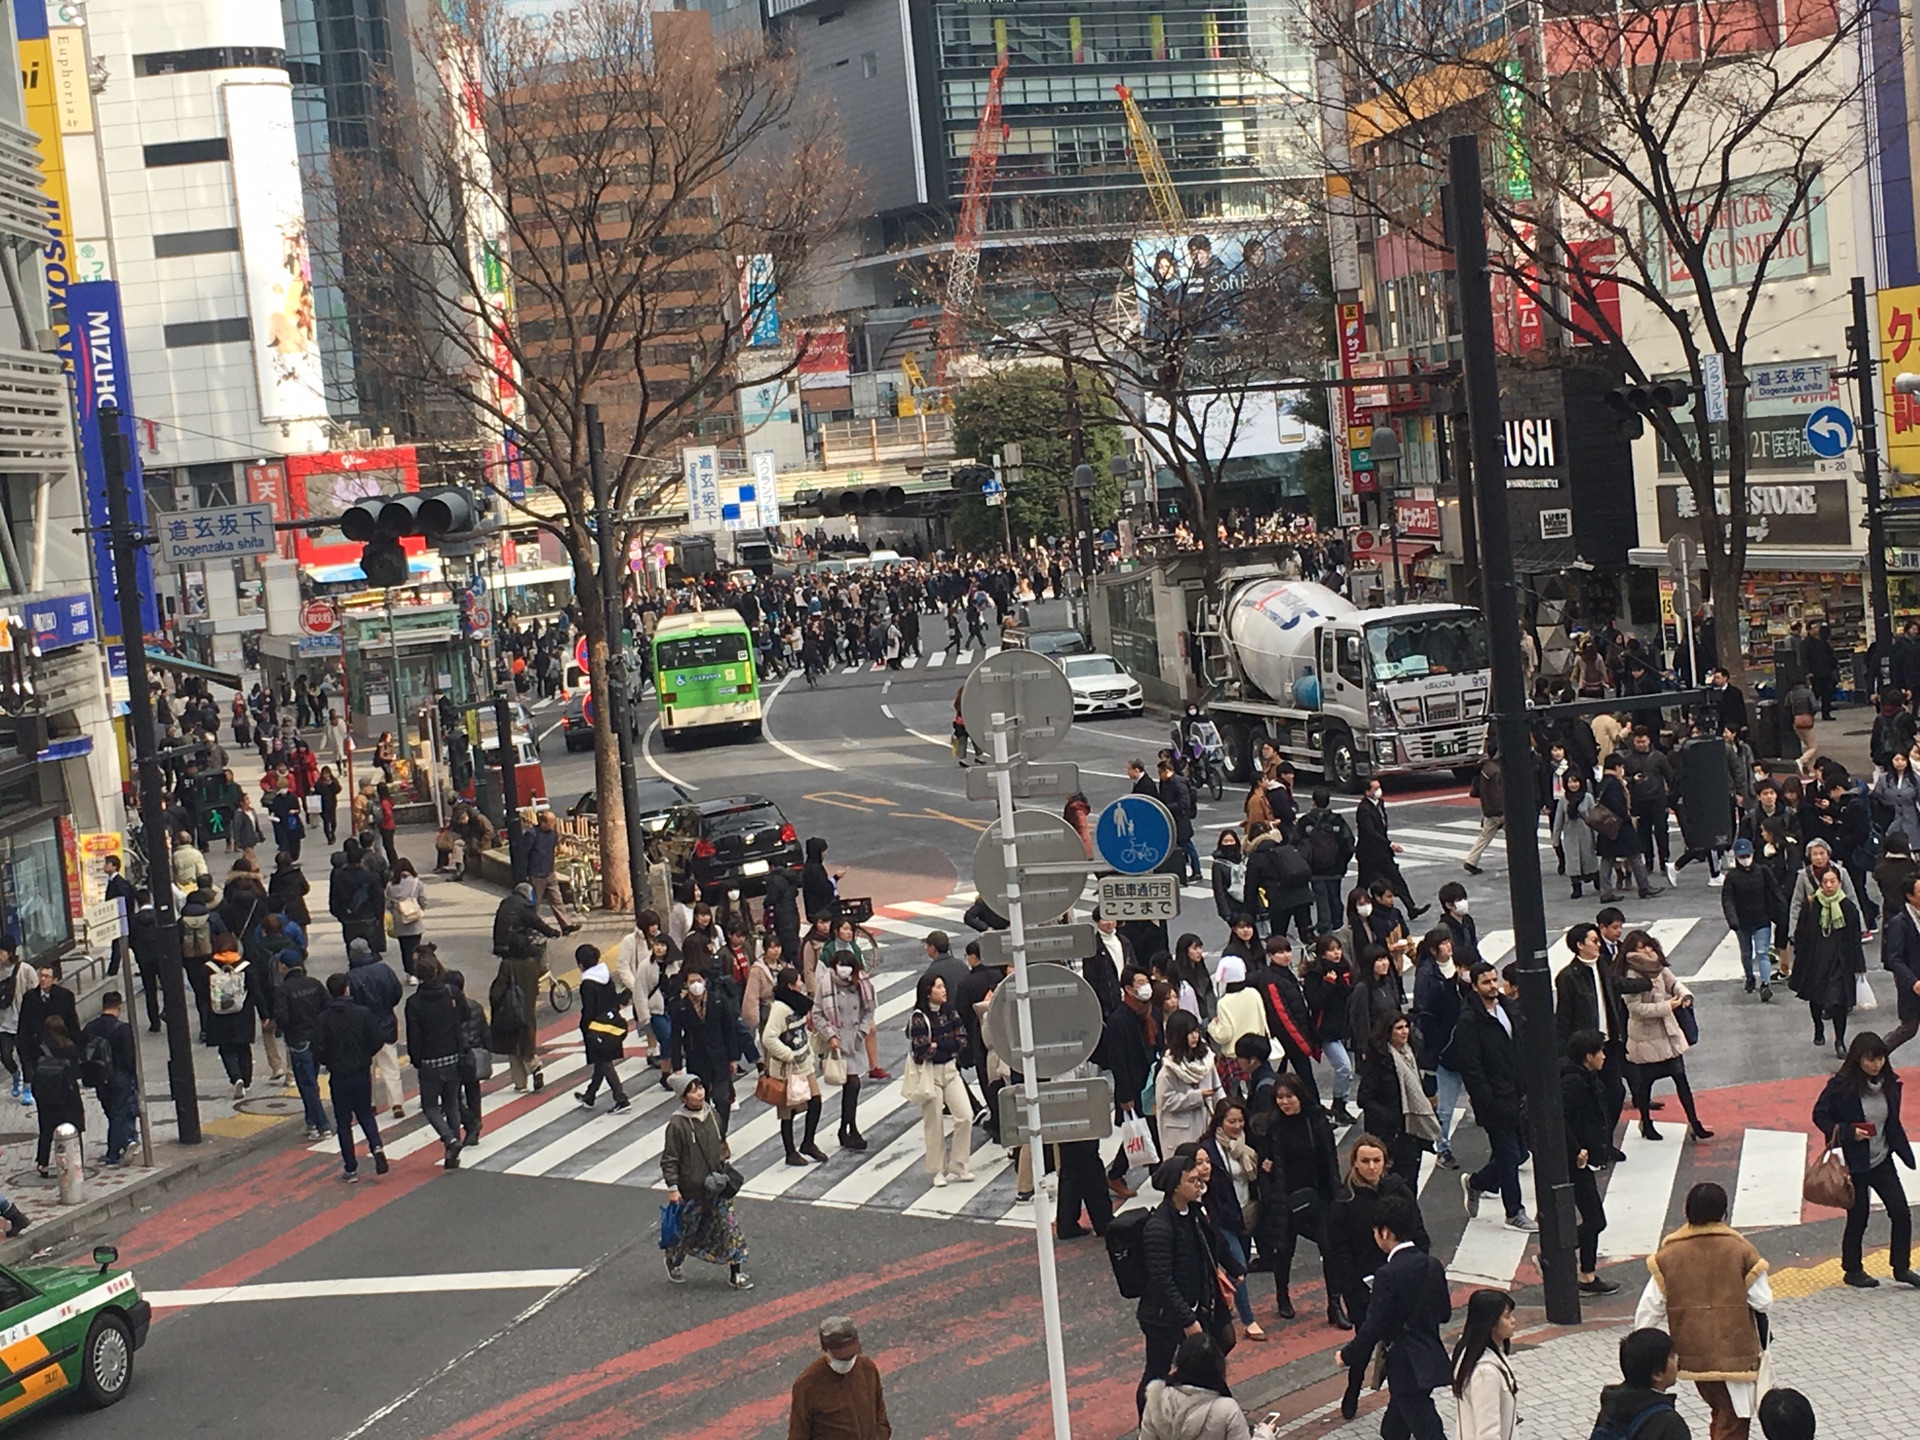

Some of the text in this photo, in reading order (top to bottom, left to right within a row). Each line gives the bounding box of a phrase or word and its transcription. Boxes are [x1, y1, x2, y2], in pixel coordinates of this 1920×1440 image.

[57, 35, 75, 114] Euphoria
[1524, 333, 1537, 344] 3F
[1757, 366, 1822, 386] 道玄坂下
[1759, 385, 1803, 396] Dogenzaka
[1504, 419, 1554, 467] USH
[699, 454, 717, 525] 道玄坂下
[1750, 486, 1818, 515] STORE
[168, 511, 262, 541] 道玄坂下
[173, 536, 265, 556] Dogenzaka shita
[1472, 676, 1488, 687] 910
[1103, 883, 1171, 898] 自転車通行可
[1105, 901, 1172, 915] ここまで
